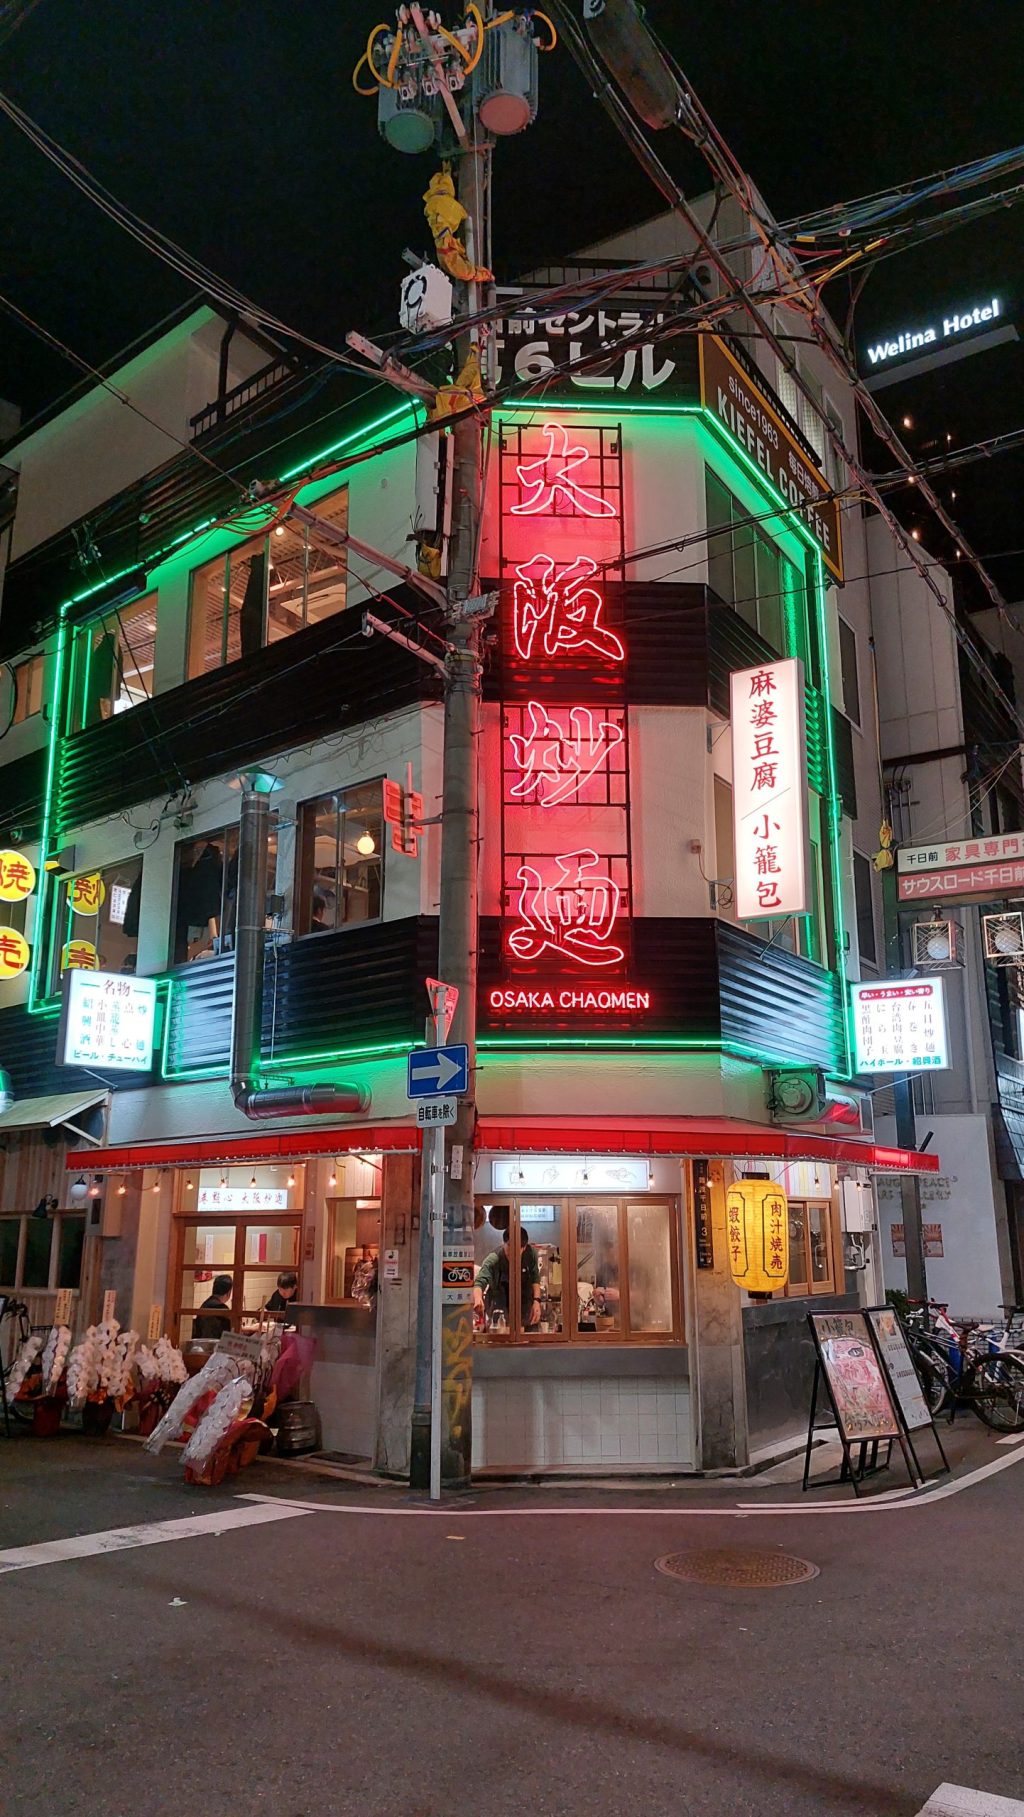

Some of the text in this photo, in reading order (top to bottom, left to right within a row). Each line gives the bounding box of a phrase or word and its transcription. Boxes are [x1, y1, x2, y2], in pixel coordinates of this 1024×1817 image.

[867, 298, 1000, 364] Welina Hotel
[718, 386, 775, 484] KIEFEL
[748, 669, 779, 792] 麻婆豆腐
[752, 813, 782, 909] 小籠包
[906, 837, 1024, 865] 千日前 家具専門
[104, 979, 131, 997] 名物
[489, 990, 650, 1009] OSAKA CHAOMEN
[418, 1103, 455, 1121] 自転車を除く
[728, 1206, 742, 1263] 蝦餃子
[769, 1200, 784, 1270] 肉汁焼売
